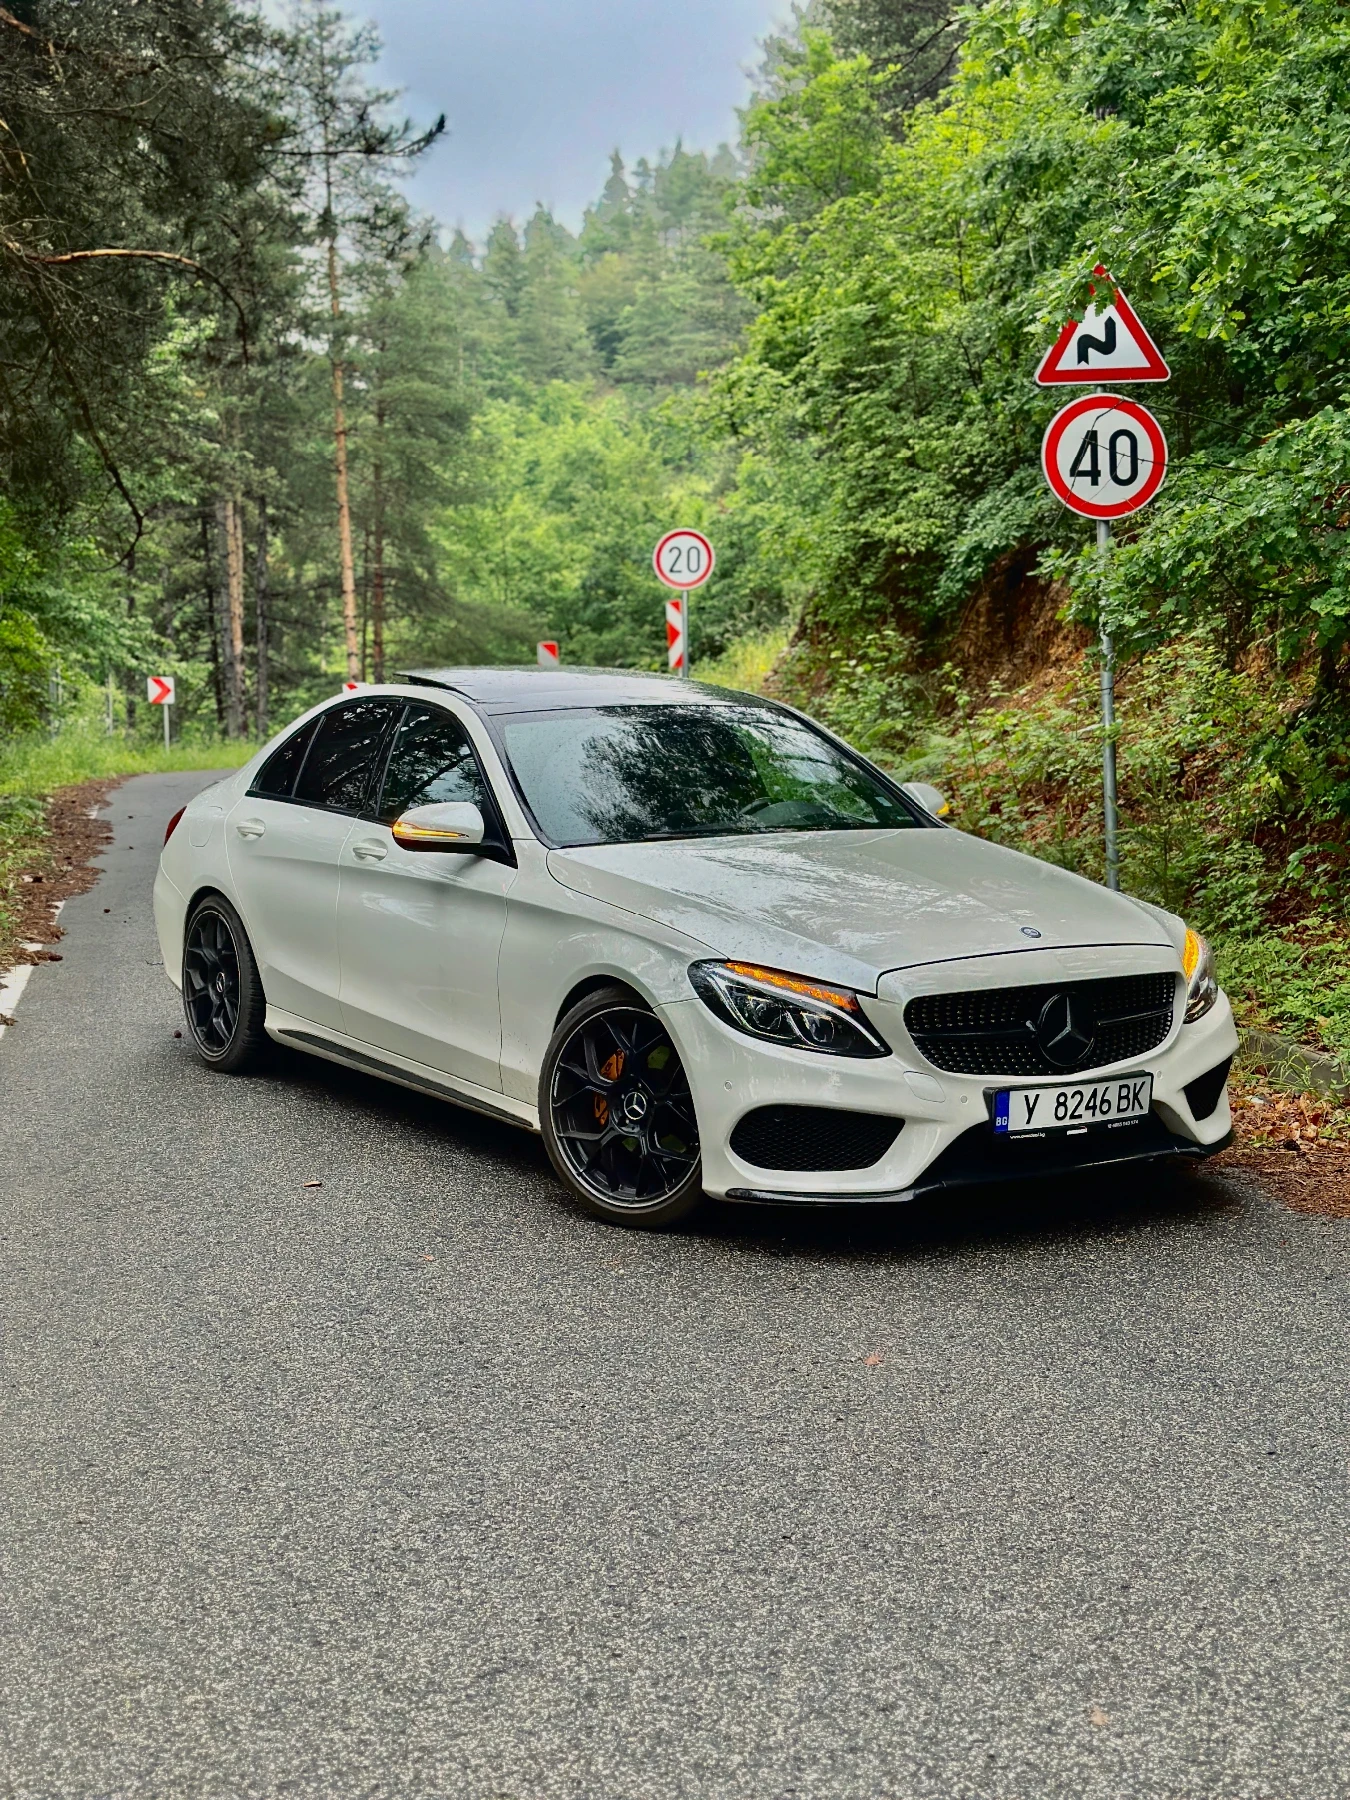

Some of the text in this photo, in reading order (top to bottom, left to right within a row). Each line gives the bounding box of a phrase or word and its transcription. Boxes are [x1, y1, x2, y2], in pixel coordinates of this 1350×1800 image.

[1070, 429, 1138, 486] 40
[669, 546, 700, 573] 20
[995, 1116, 1008, 1126] BG
